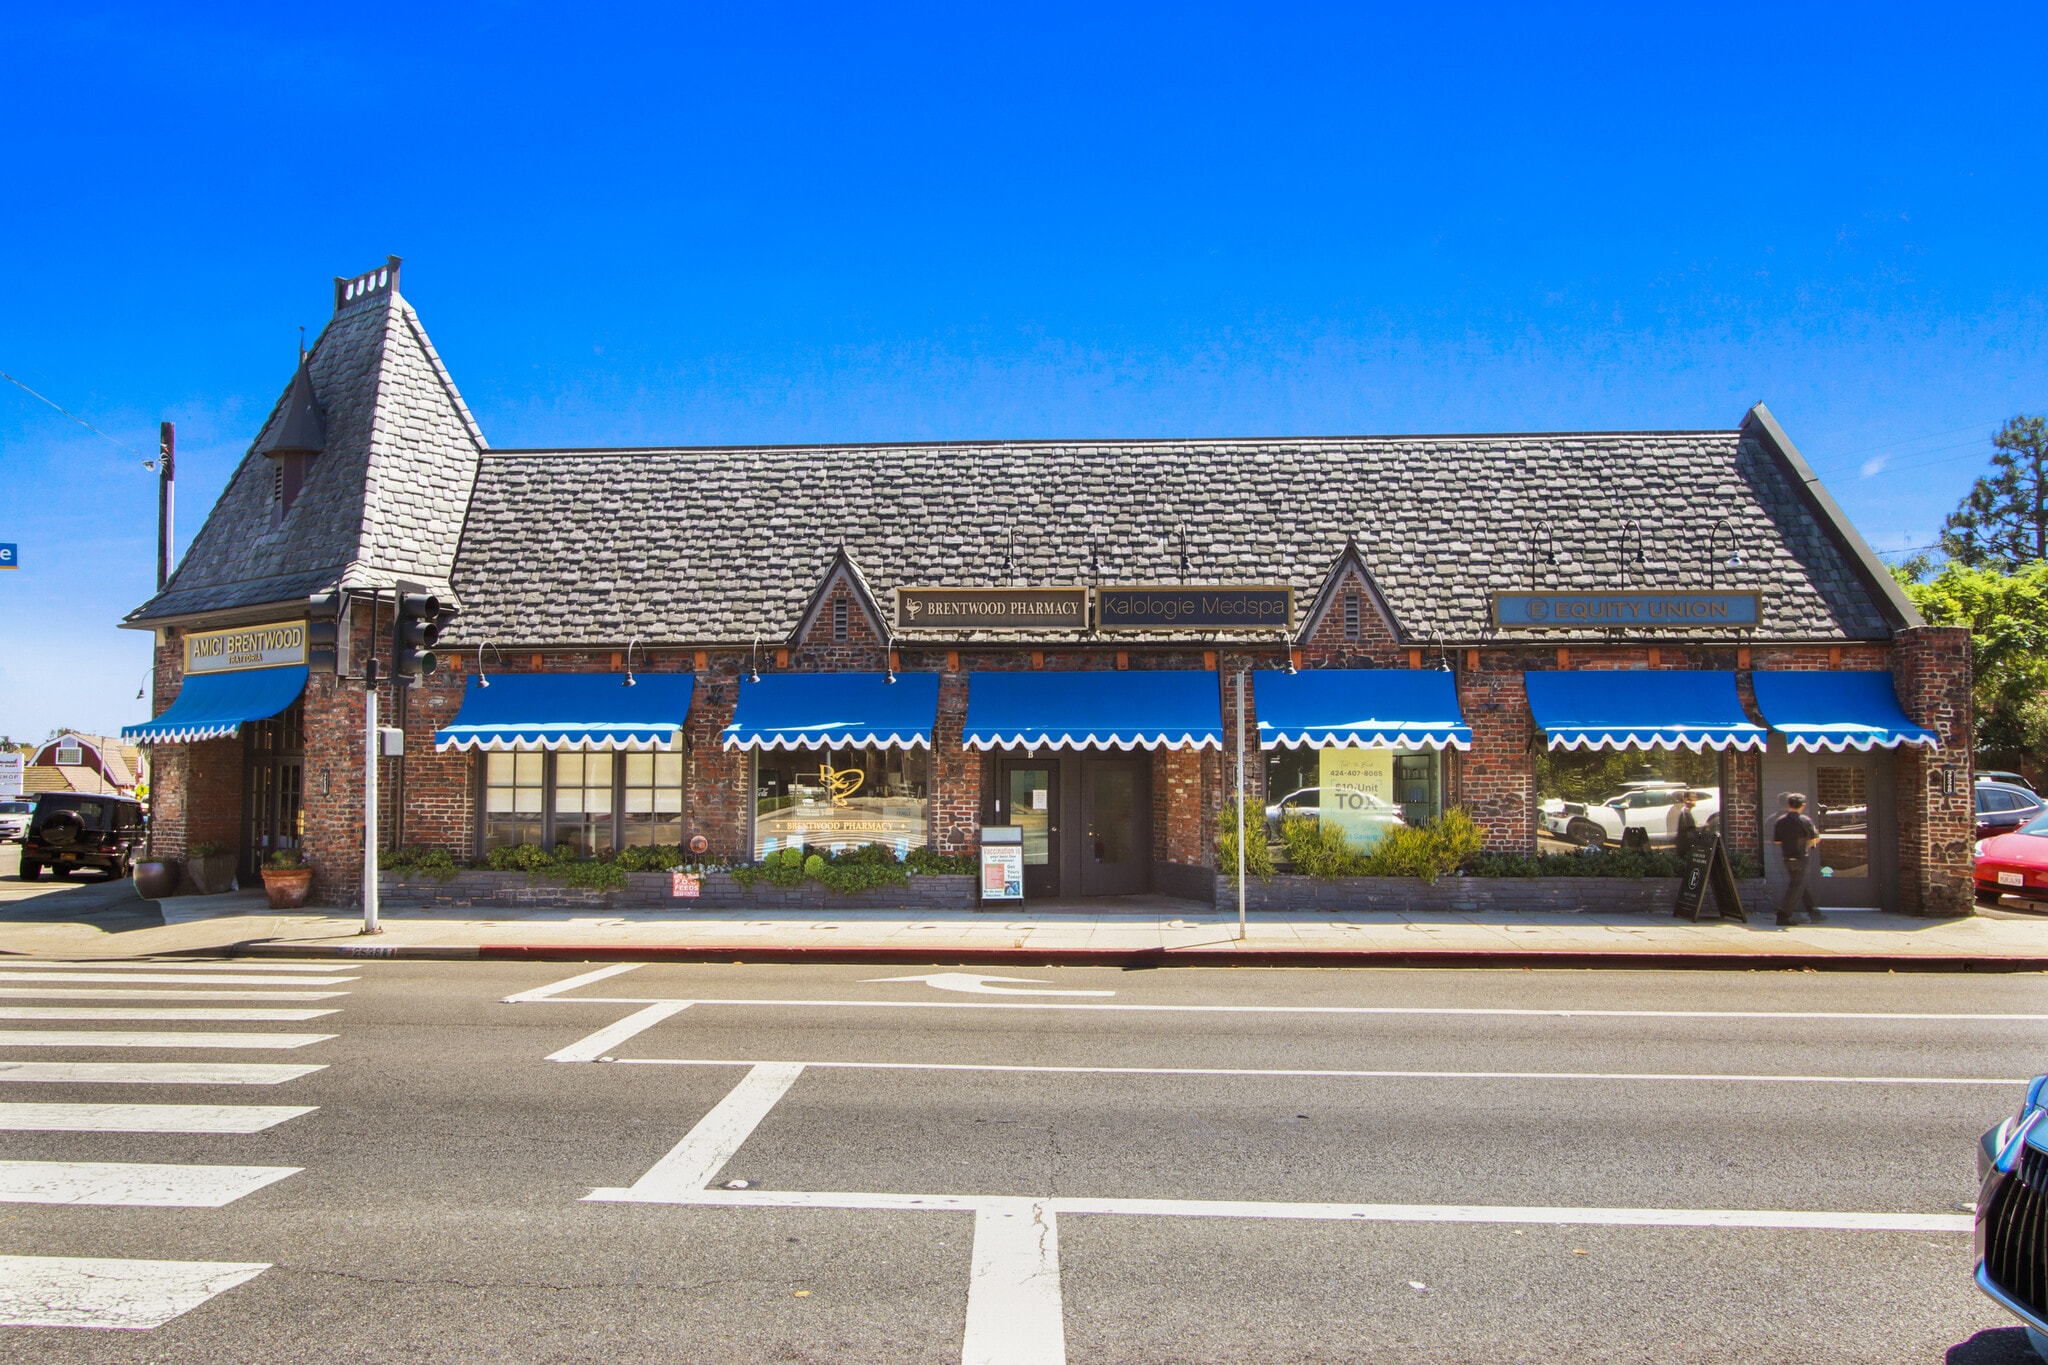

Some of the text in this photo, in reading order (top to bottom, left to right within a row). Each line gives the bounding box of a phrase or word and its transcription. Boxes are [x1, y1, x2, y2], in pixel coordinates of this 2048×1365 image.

[927, 602, 1079, 615] BRENTWOOD PHARMACY
[1104, 596, 1285, 620] Kalologie Medspa
[1554, 601, 1643, 619] EQUITY
[1649, 601, 1728, 618] UNION
[193, 628, 302, 658] AMICI BRENTWOOD
[228, 653, 262, 664] TRATTORIA
[1334, 793, 1378, 810] TOX
[787, 821, 894, 831] BRENTWOOD PHARMACY
